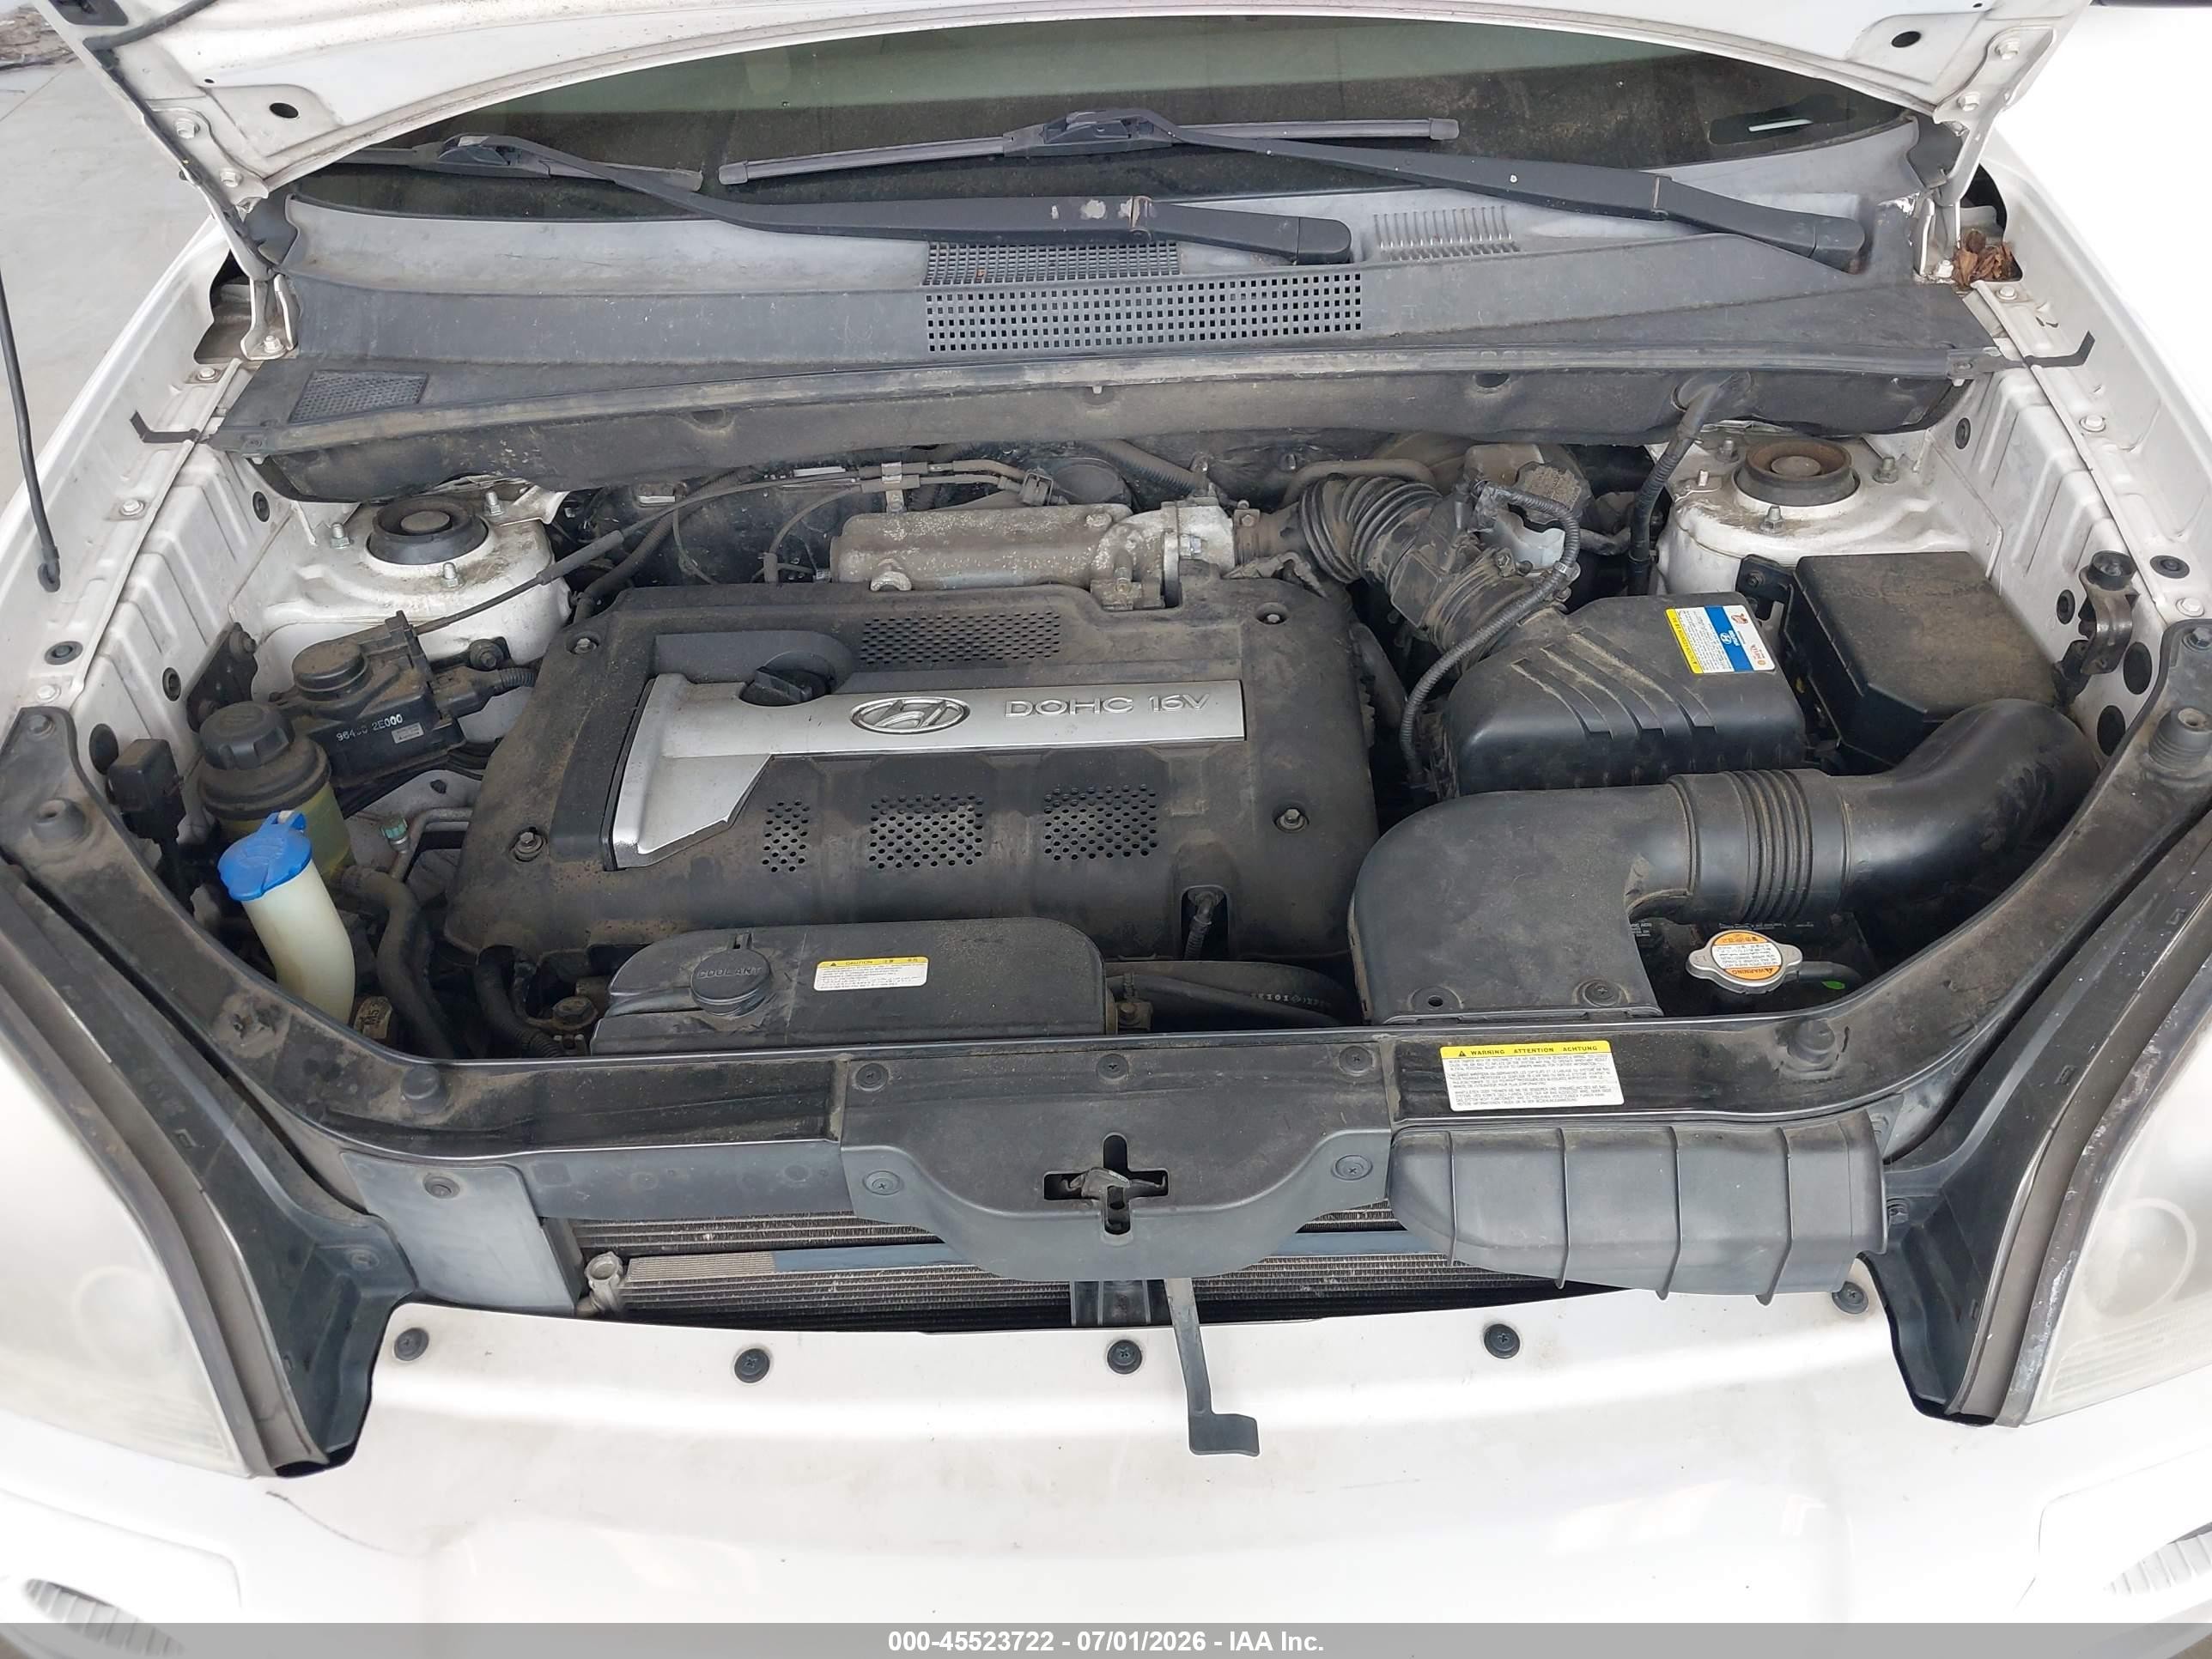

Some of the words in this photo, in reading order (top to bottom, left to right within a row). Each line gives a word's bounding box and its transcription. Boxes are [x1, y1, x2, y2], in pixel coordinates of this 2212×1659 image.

[1005, 696, 1133, 717] DOHC
[1149, 693, 1212, 712] 16V
[371, 714, 404, 731] 2E000
